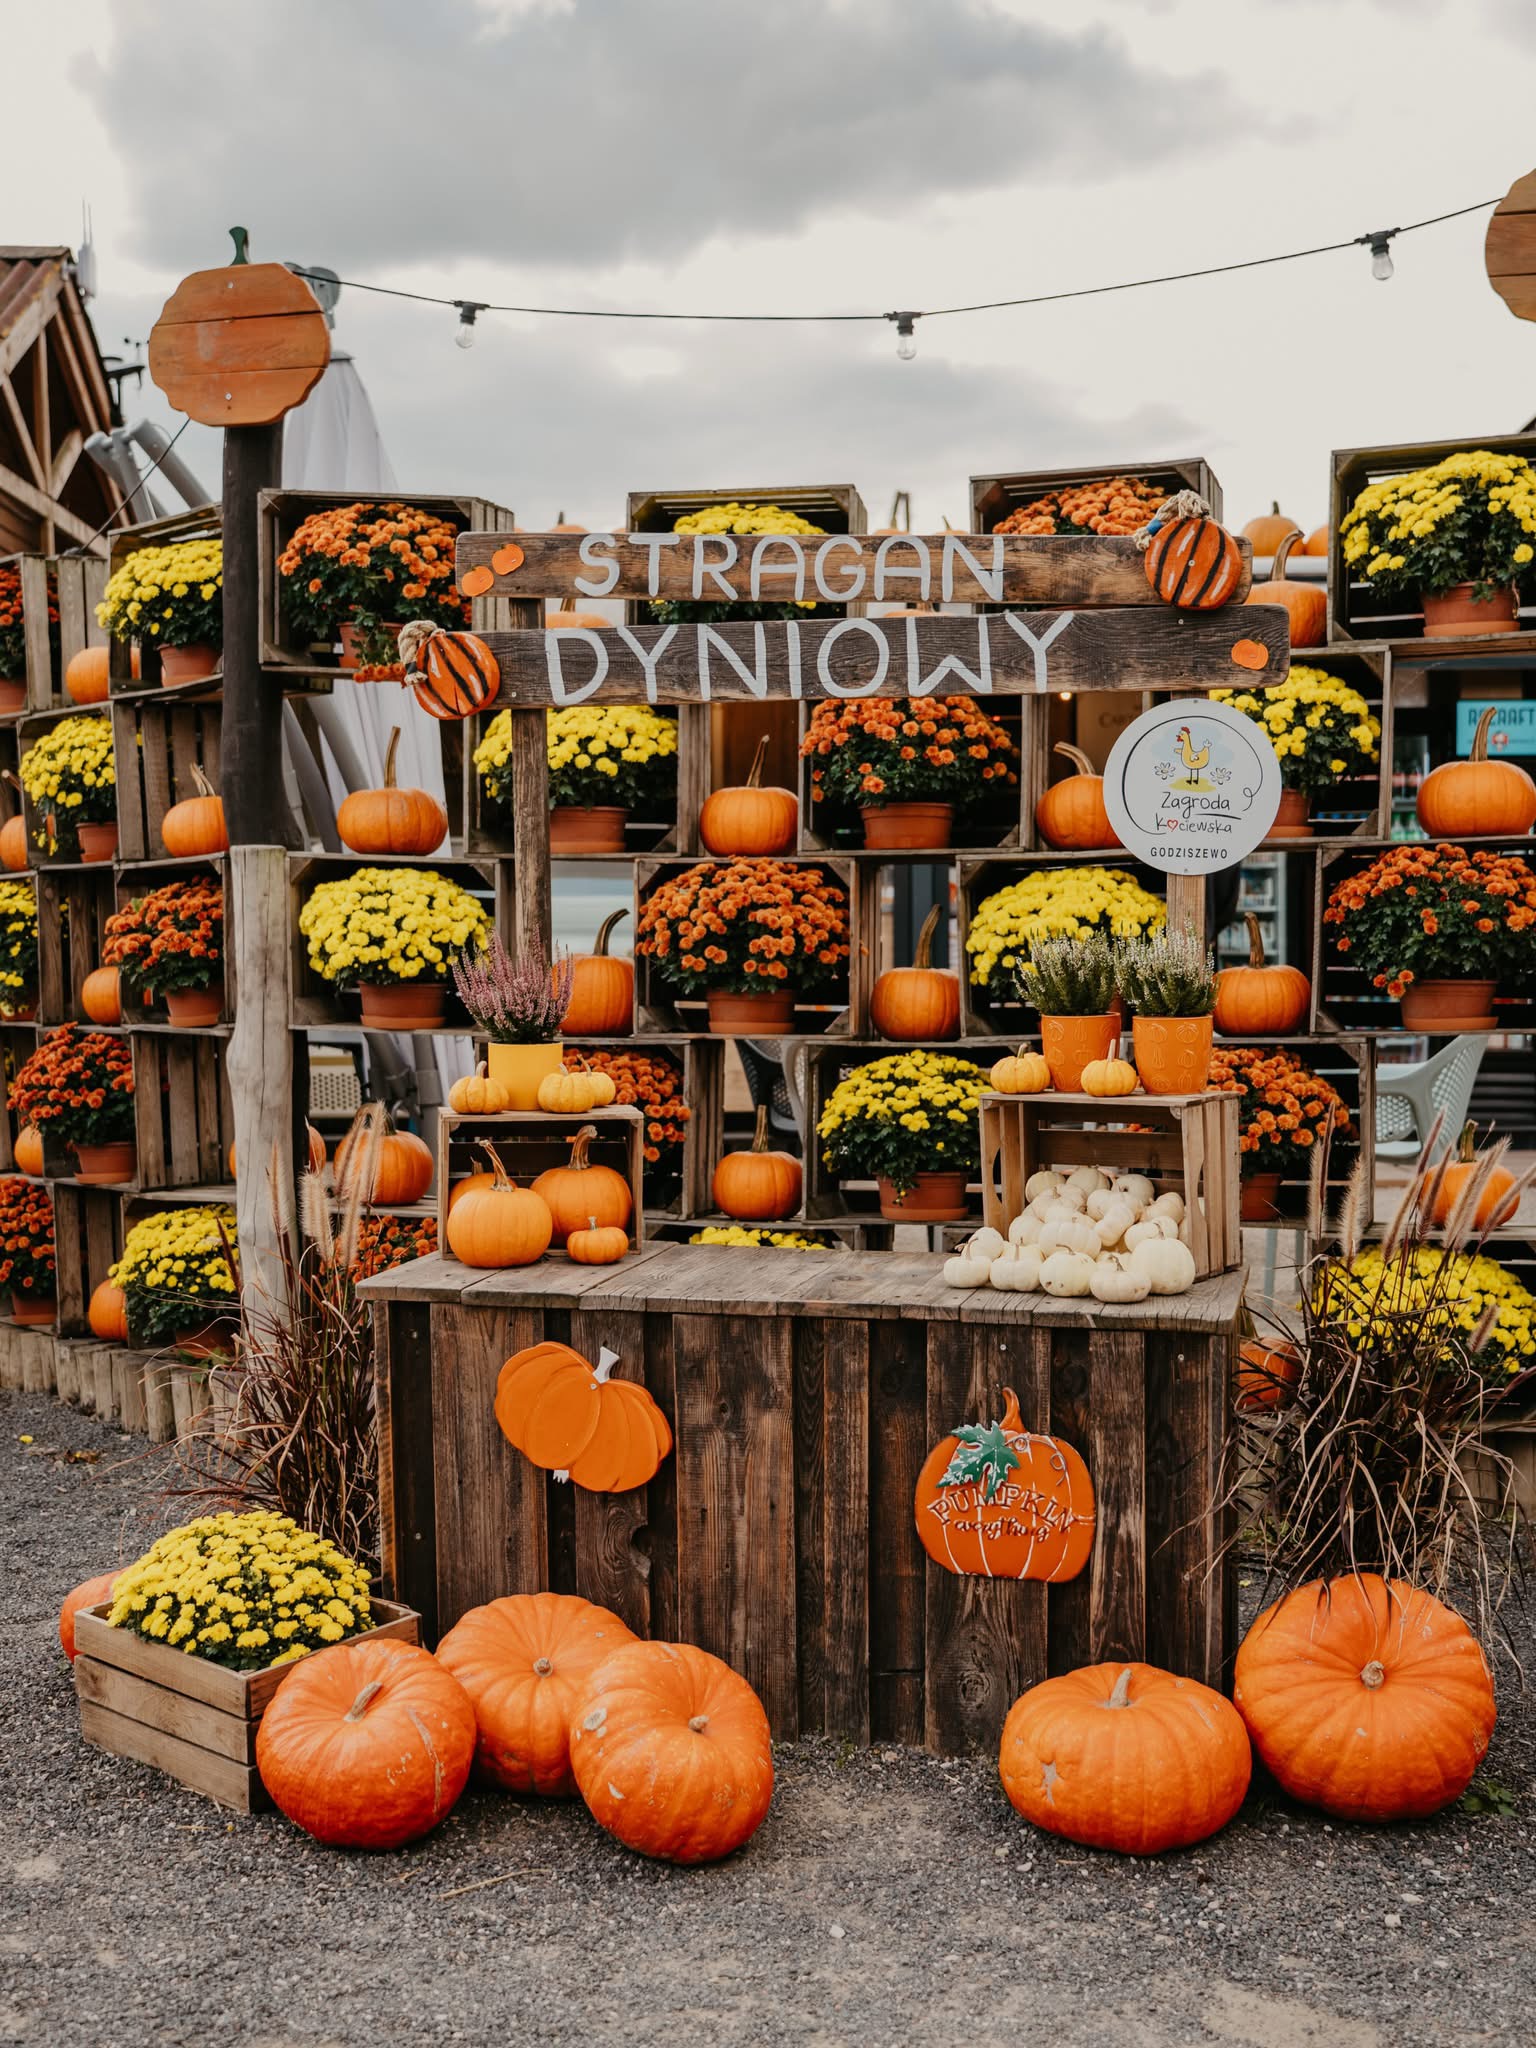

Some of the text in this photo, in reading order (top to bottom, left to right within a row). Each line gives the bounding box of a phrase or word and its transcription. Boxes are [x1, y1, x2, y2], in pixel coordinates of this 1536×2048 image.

[575, 532, 1004, 603] STRAGAN
[545, 611, 1074, 706] DYNIOWY
[1161, 791, 1231, 819] Zagroda
[1150, 847, 1228, 859] GODZISZEWO
[927, 1484, 1079, 1534] PUMPKIN
